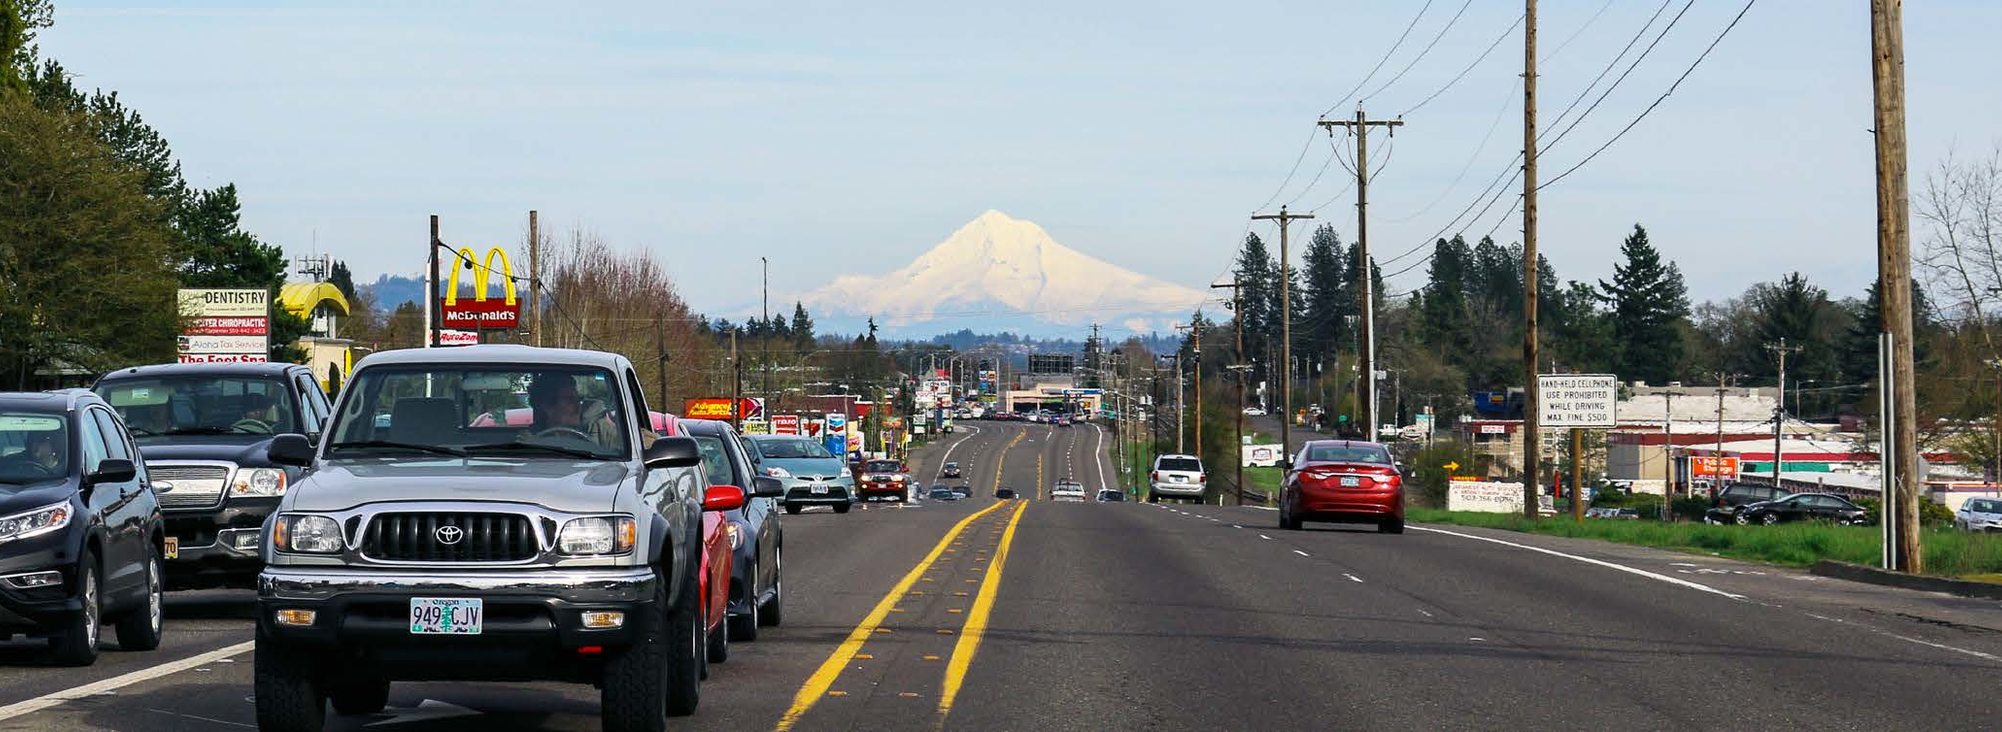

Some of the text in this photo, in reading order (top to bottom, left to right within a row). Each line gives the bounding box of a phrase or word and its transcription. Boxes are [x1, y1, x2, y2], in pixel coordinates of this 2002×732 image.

[205, 292, 265, 304] DENTISTRY
[447, 311, 515, 320] McDonald's
[218, 318, 266, 328] CHIROPRACTIC
[440, 333, 478, 341] AutoZon
[179, 354, 204, 364] The
[1541, 380, 1613, 388] HAND-HELD CELLPHONE
[1546, 391, 1608, 399] USE PROHIBITED
[1550, 402, 1605, 410] WHILE DRIVING
[1588, 413, 1607, 421] $500
[1703, 466, 1733, 474] Stoage
[414, 607, 478, 625] 949 CJV
